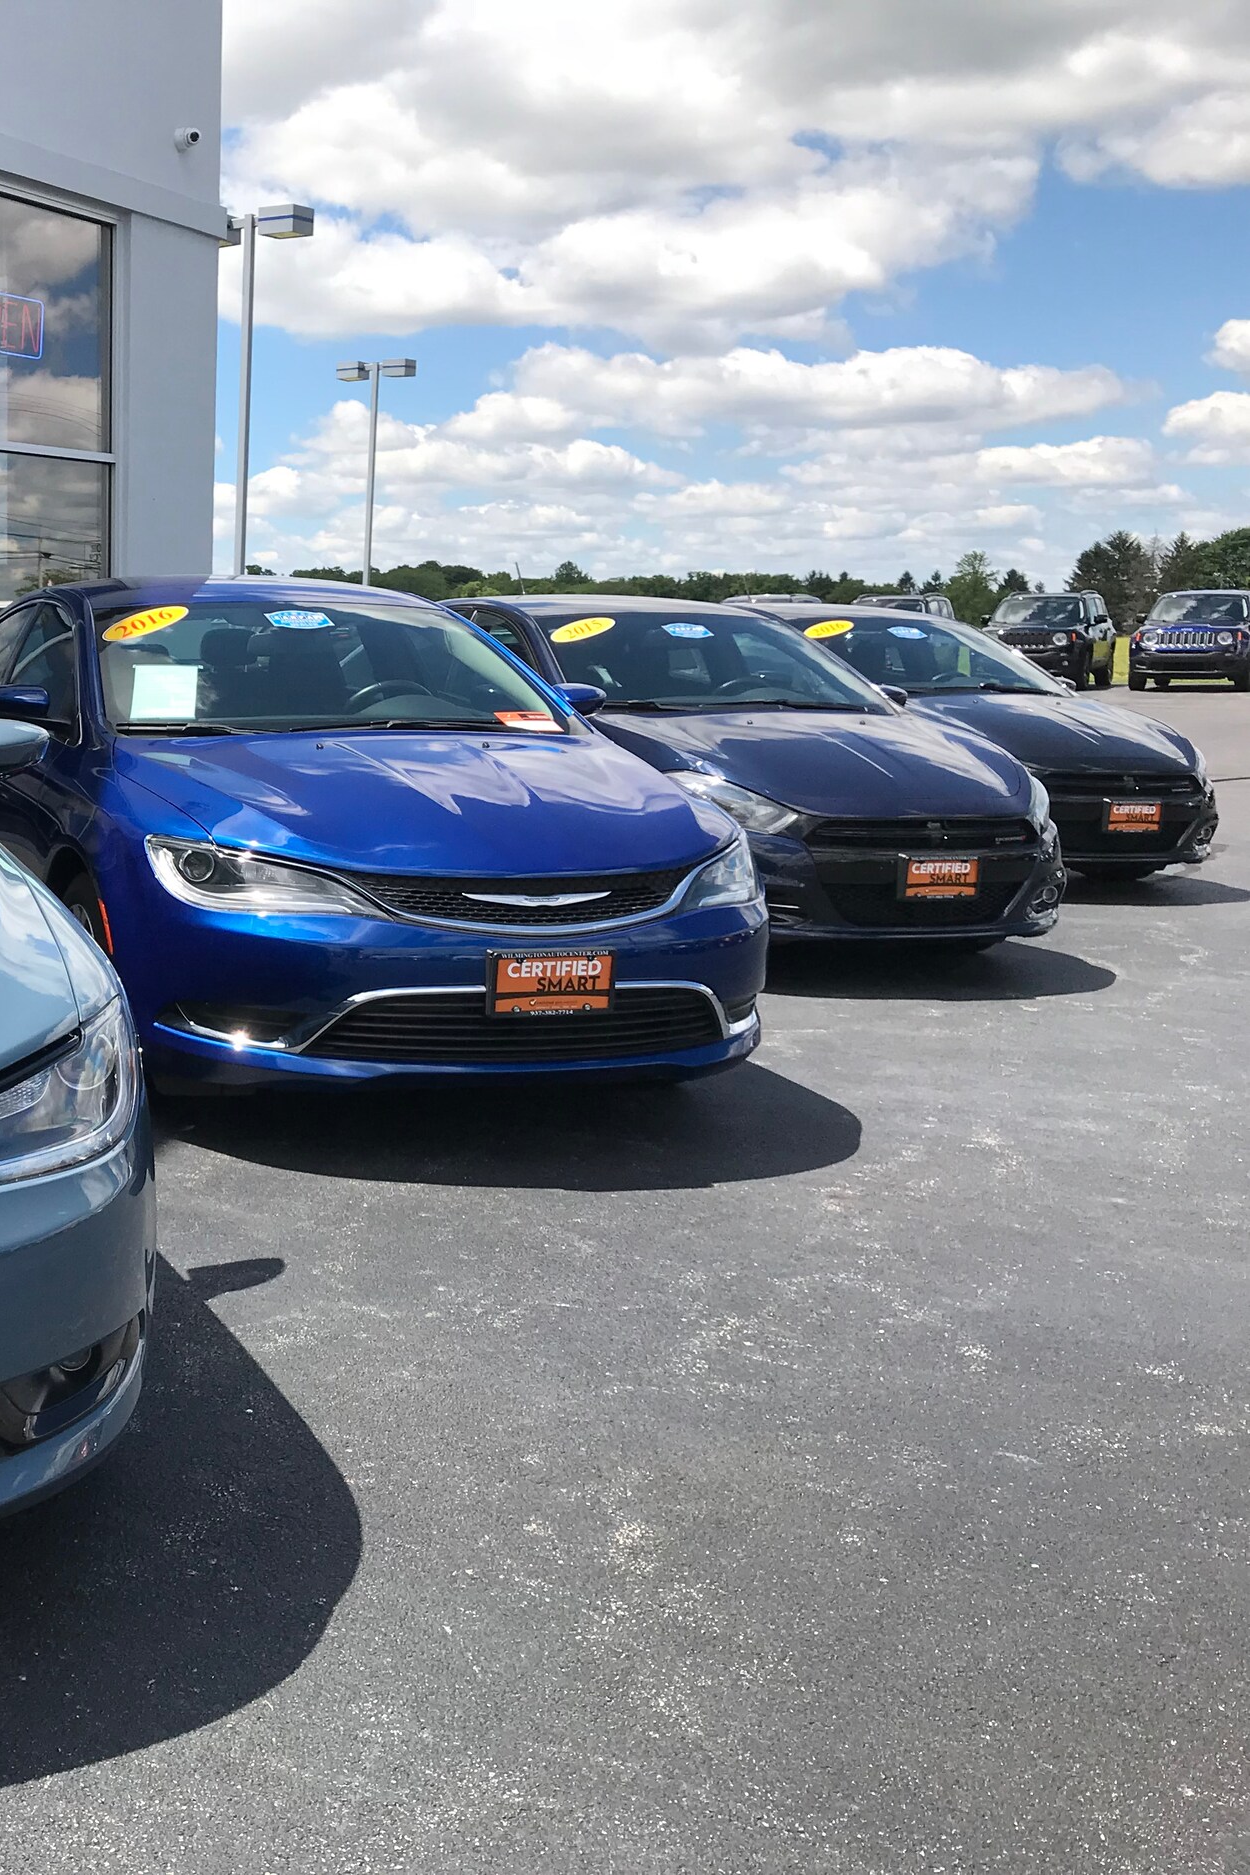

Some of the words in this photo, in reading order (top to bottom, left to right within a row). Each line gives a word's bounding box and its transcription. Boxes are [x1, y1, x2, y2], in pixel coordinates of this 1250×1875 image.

[114, 610, 173, 638] 2016
[563, 620, 602, 638] 2015
[1113, 805, 1156, 814] CERTIFIED
[1126, 814, 1155, 823] SMART
[911, 862, 971, 874] CERTIFIED
[929, 873, 969, 884] SMART
[507, 960, 602, 978] CERTIFIED
[536, 975, 600, 992] SMART
